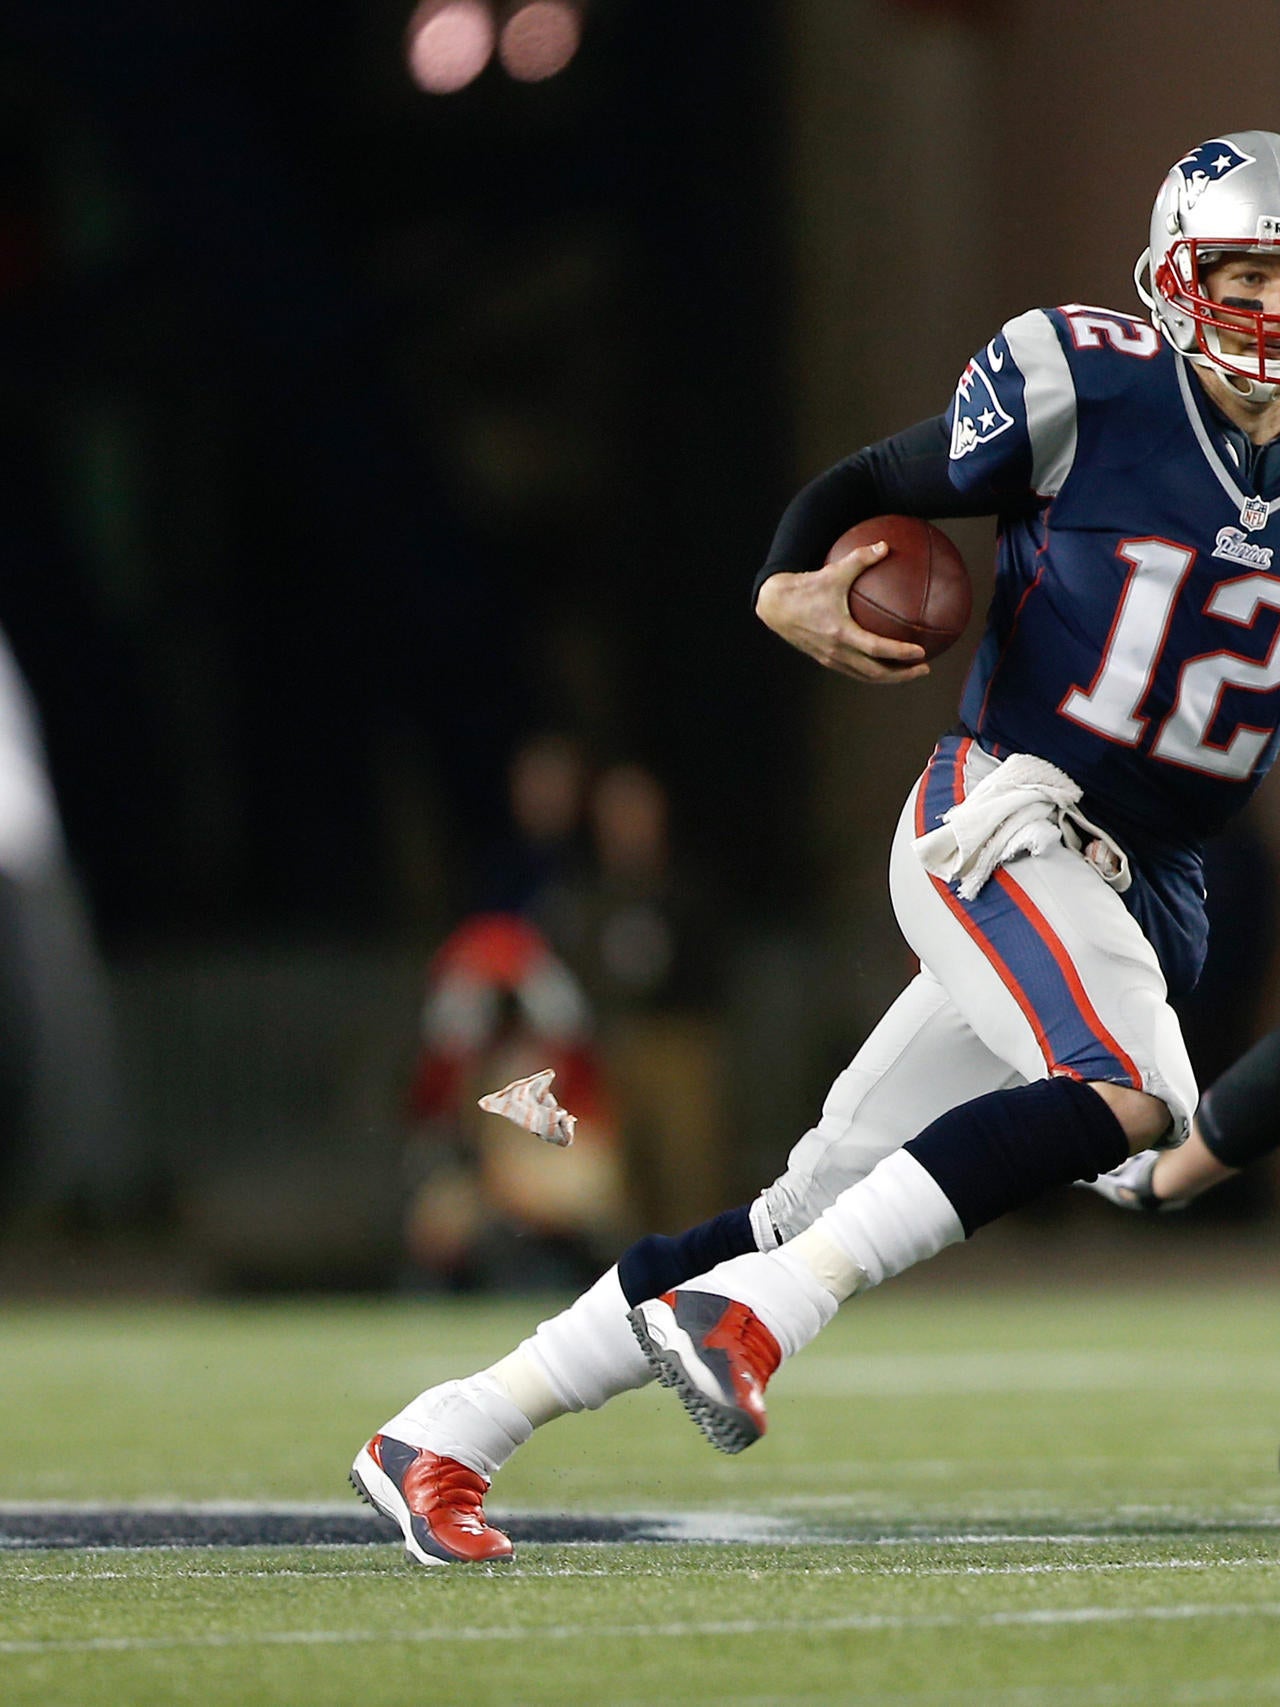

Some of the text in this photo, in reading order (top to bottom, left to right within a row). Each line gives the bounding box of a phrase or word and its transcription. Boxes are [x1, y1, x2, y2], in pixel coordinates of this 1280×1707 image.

[1057, 303, 1162, 360] 12
[1245, 510, 1263, 525] NFL
[1213, 537, 1275, 566] Patriots
